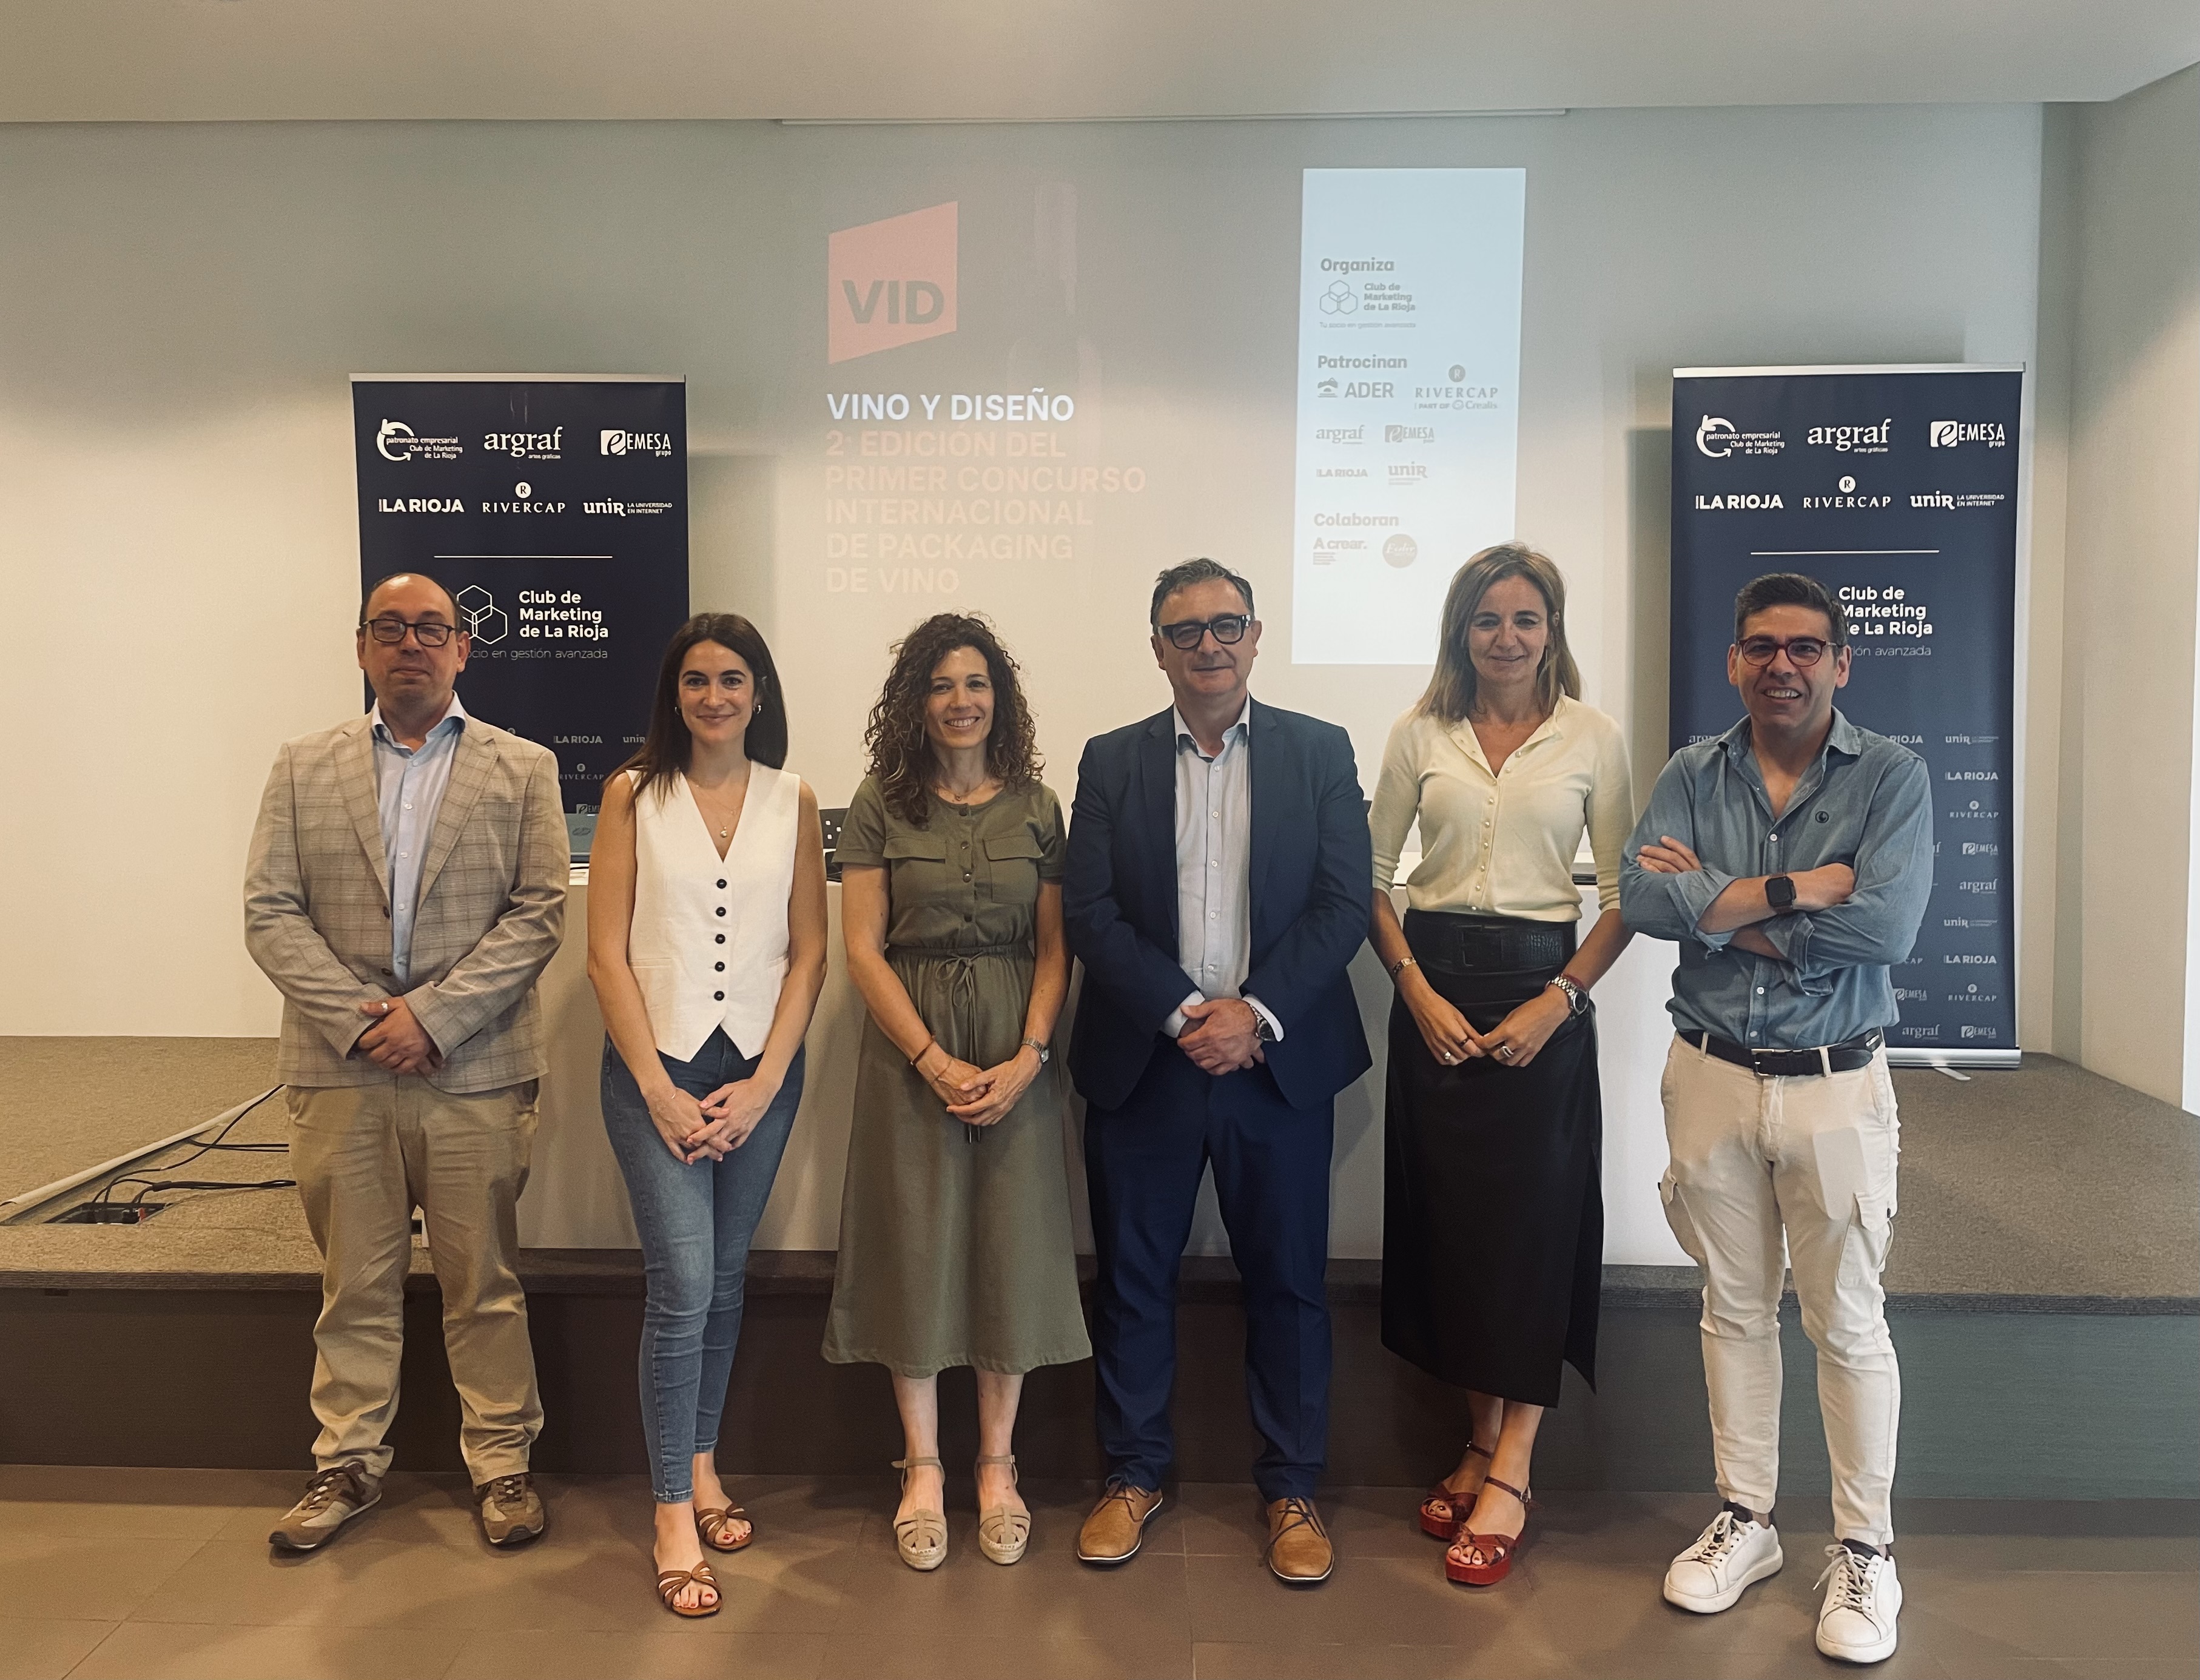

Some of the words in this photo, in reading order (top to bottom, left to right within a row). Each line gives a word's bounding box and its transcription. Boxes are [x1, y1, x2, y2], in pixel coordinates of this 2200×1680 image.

[1320, 257, 1394, 275] Organiza
[841, 279, 944, 324] VID
[1364, 293, 1412, 302] Marketing
[1391, 303, 1416, 312] Rioja
[1317, 354, 1407, 369] Patrocinan
[1344, 381, 1394, 398] ADER
[1415, 387, 1498, 398] RIVERCAP
[827, 393, 910, 420] VINO
[920, 394, 941, 420] Y
[950, 387, 1075, 421] DISEÑO
[1316, 425, 1365, 444] argraf
[1403, 426, 1435, 439] EMESA
[1706, 432, 1740, 441] patronato
[1741, 431, 1780, 440] empresarial
[1807, 418, 1891, 451] argraf
[1958, 423, 2005, 441] EMESA
[420, 437, 459, 445] empresarial
[483, 426, 563, 457] argraf
[627, 433, 671, 449] EMESA
[860, 423, 996, 457] EDICIÓN
[1007, 431, 1066, 458] DEL
[1755, 440, 1785, 448] Marketing
[826, 466, 948, 492] PRIMER
[957, 466, 1146, 493] CONCURSO
[1319, 469, 1333, 477] LA
[1335, 469, 1368, 477] RIOJA
[383, 499, 406, 512] LA
[409, 499, 465, 512] RIOJA
[482, 502, 565, 512] RIVERCAP
[1700, 495, 1724, 509] LA
[1727, 494, 1784, 509] RIOJA
[1803, 496, 1891, 508] RIVERCAP
[826, 499, 1094, 525] INTERNACIONAL
[1313, 512, 1399, 526] Colaboran
[826, 533, 869, 559] DE
[878, 533, 1074, 560] PACKAGING
[1313, 537, 1325, 549] A
[826, 567, 869, 593] DE
[877, 567, 961, 594] VINO
[519, 590, 556, 603] Club
[560, 590, 581, 603] de
[1838, 586, 1877, 600] Club
[1882, 586, 1905, 600] de
[519, 607, 602, 623] Marketing
[1841, 603, 1926, 620] Marketing
[519, 624, 540, 637] de
[545, 625, 563, 637] La
[568, 624, 608, 640] Rioja
[1846, 622, 1860, 635] e
[1865, 622, 1884, 635] La
[1889, 620, 1933, 638] Rioja
[468, 648, 488, 658] ocio
[511, 648, 551, 660] gestión
[555, 648, 608, 659] avanzada
[1875, 645, 1931, 656] avanzada
[1948, 771, 1962, 780] LA
[1964, 771, 1999, 781] RIOJA
[1959, 878, 1999, 893] argraf
[1946, 955, 1963, 964] LA
[1963, 955, 1997, 964] RIOJA
[1902, 1024, 1940, 1038] argraf
